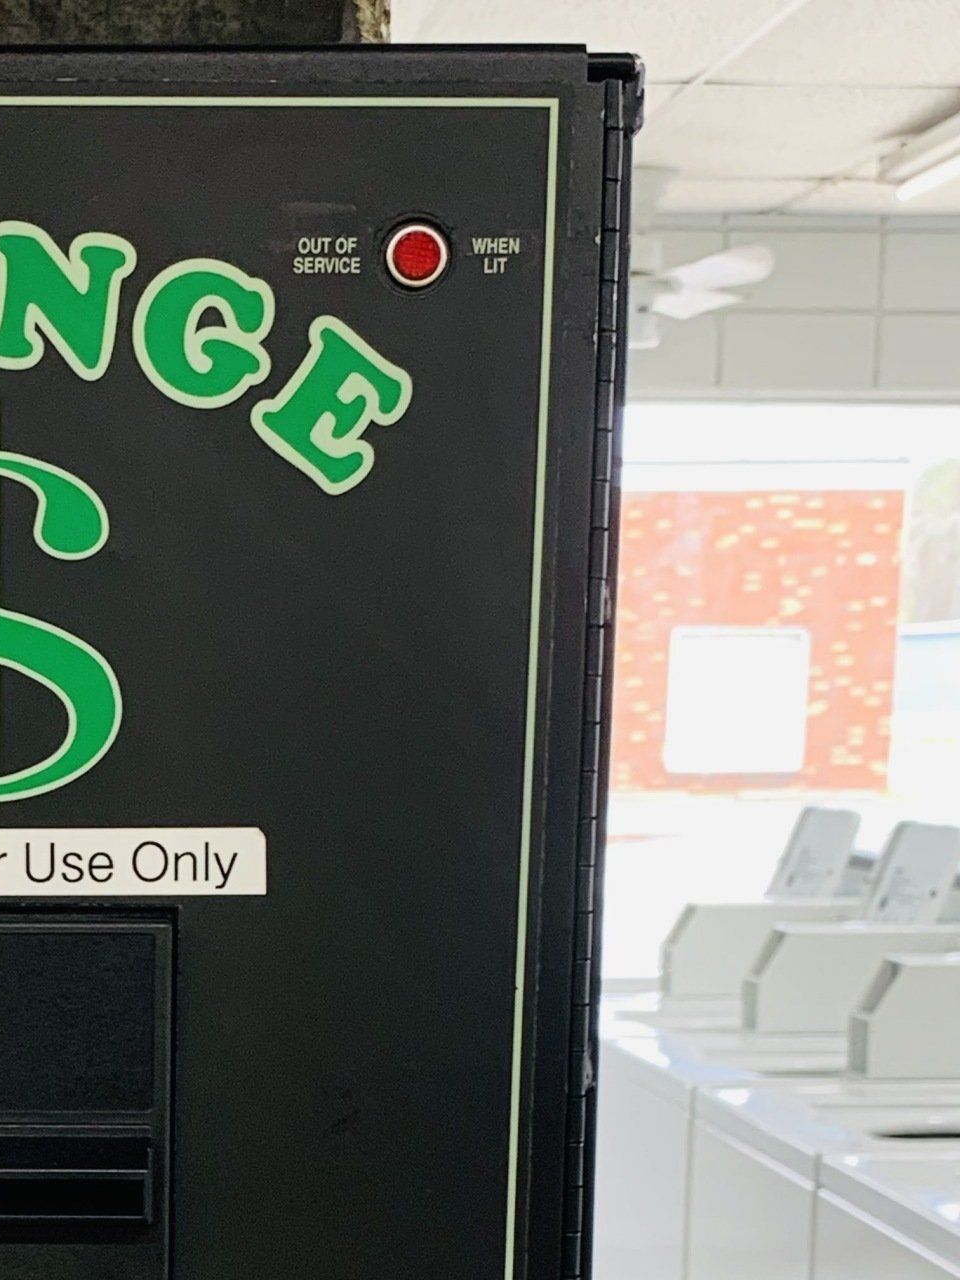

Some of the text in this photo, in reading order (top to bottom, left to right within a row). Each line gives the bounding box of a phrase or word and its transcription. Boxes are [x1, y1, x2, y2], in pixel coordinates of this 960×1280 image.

[298, 237, 357, 254] OUT OF
[472, 237, 520, 254] WHEN
[293, 257, 361, 274] SERVICE
[483, 257, 508, 274] LIT
[24, 841, 114, 884] Use
[131, 840, 238, 890] Only
